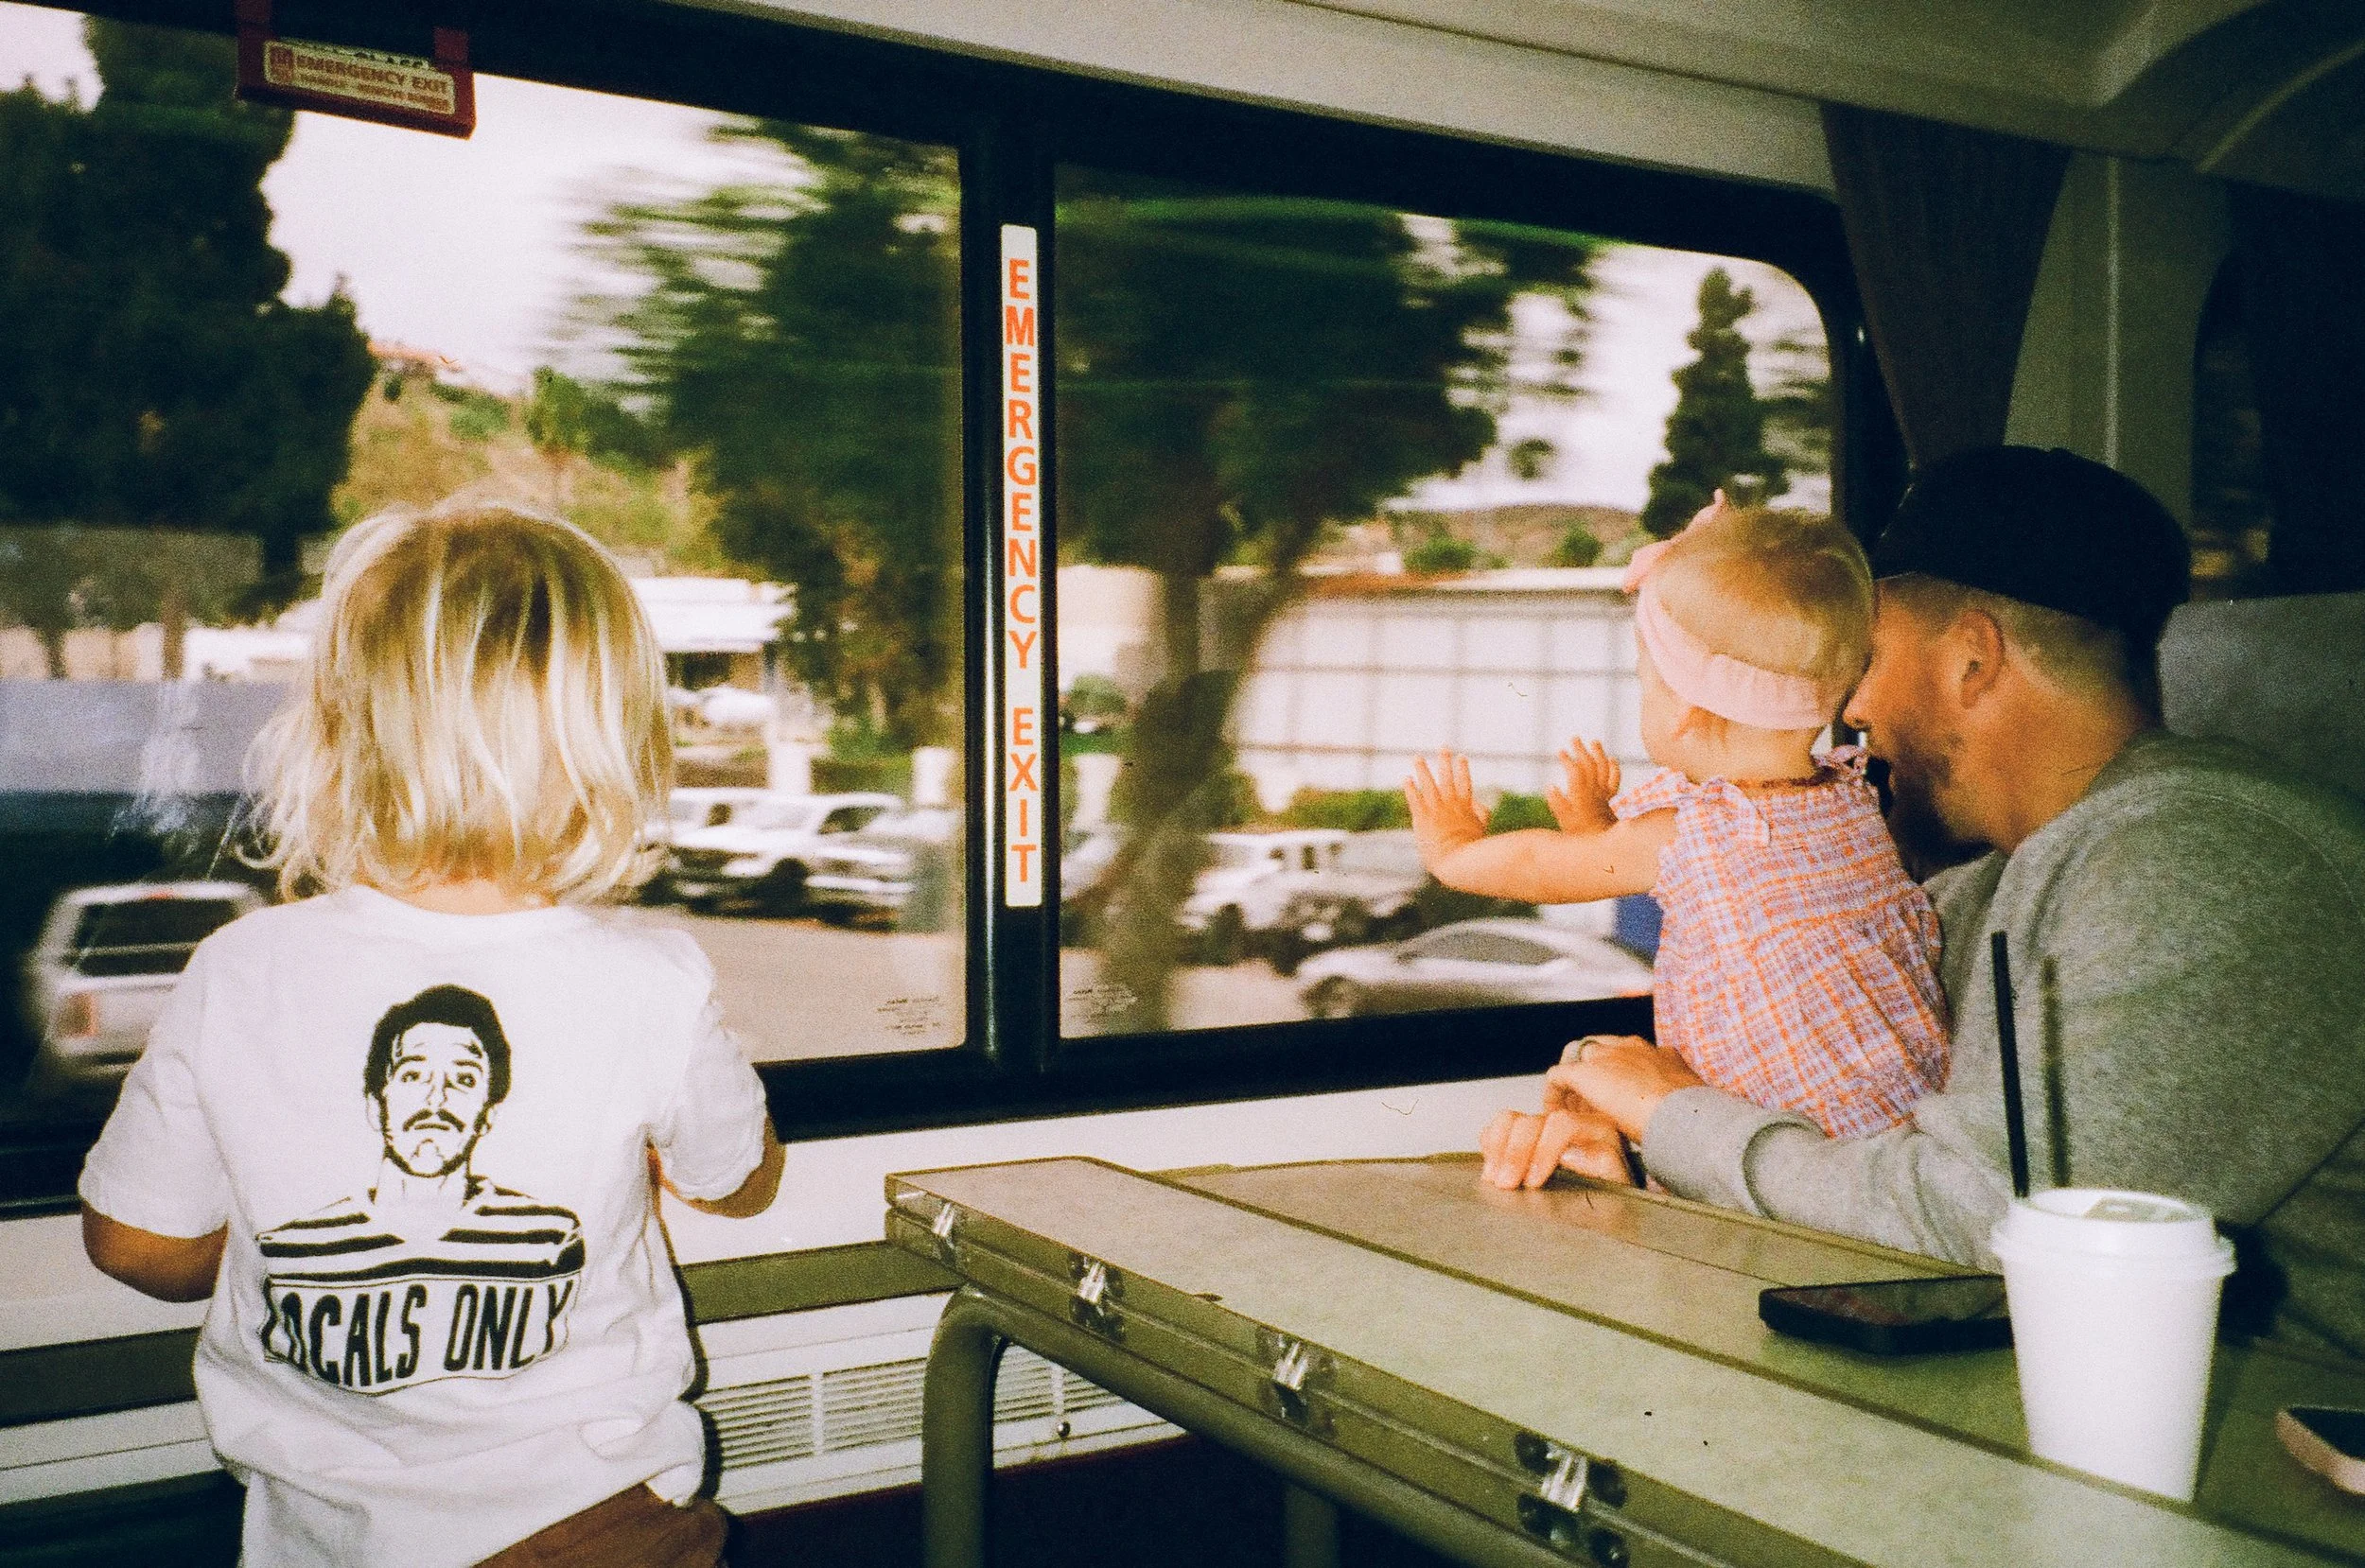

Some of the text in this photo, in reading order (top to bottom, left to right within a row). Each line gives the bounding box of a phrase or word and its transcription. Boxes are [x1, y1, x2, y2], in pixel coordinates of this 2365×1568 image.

[297, 55, 405, 86] EMERGENCY
[412, 76, 447, 94] EXIT
[1005, 258, 1037, 882] EMERGENCY EXIT
[444, 1280, 573, 1370] ONLY
